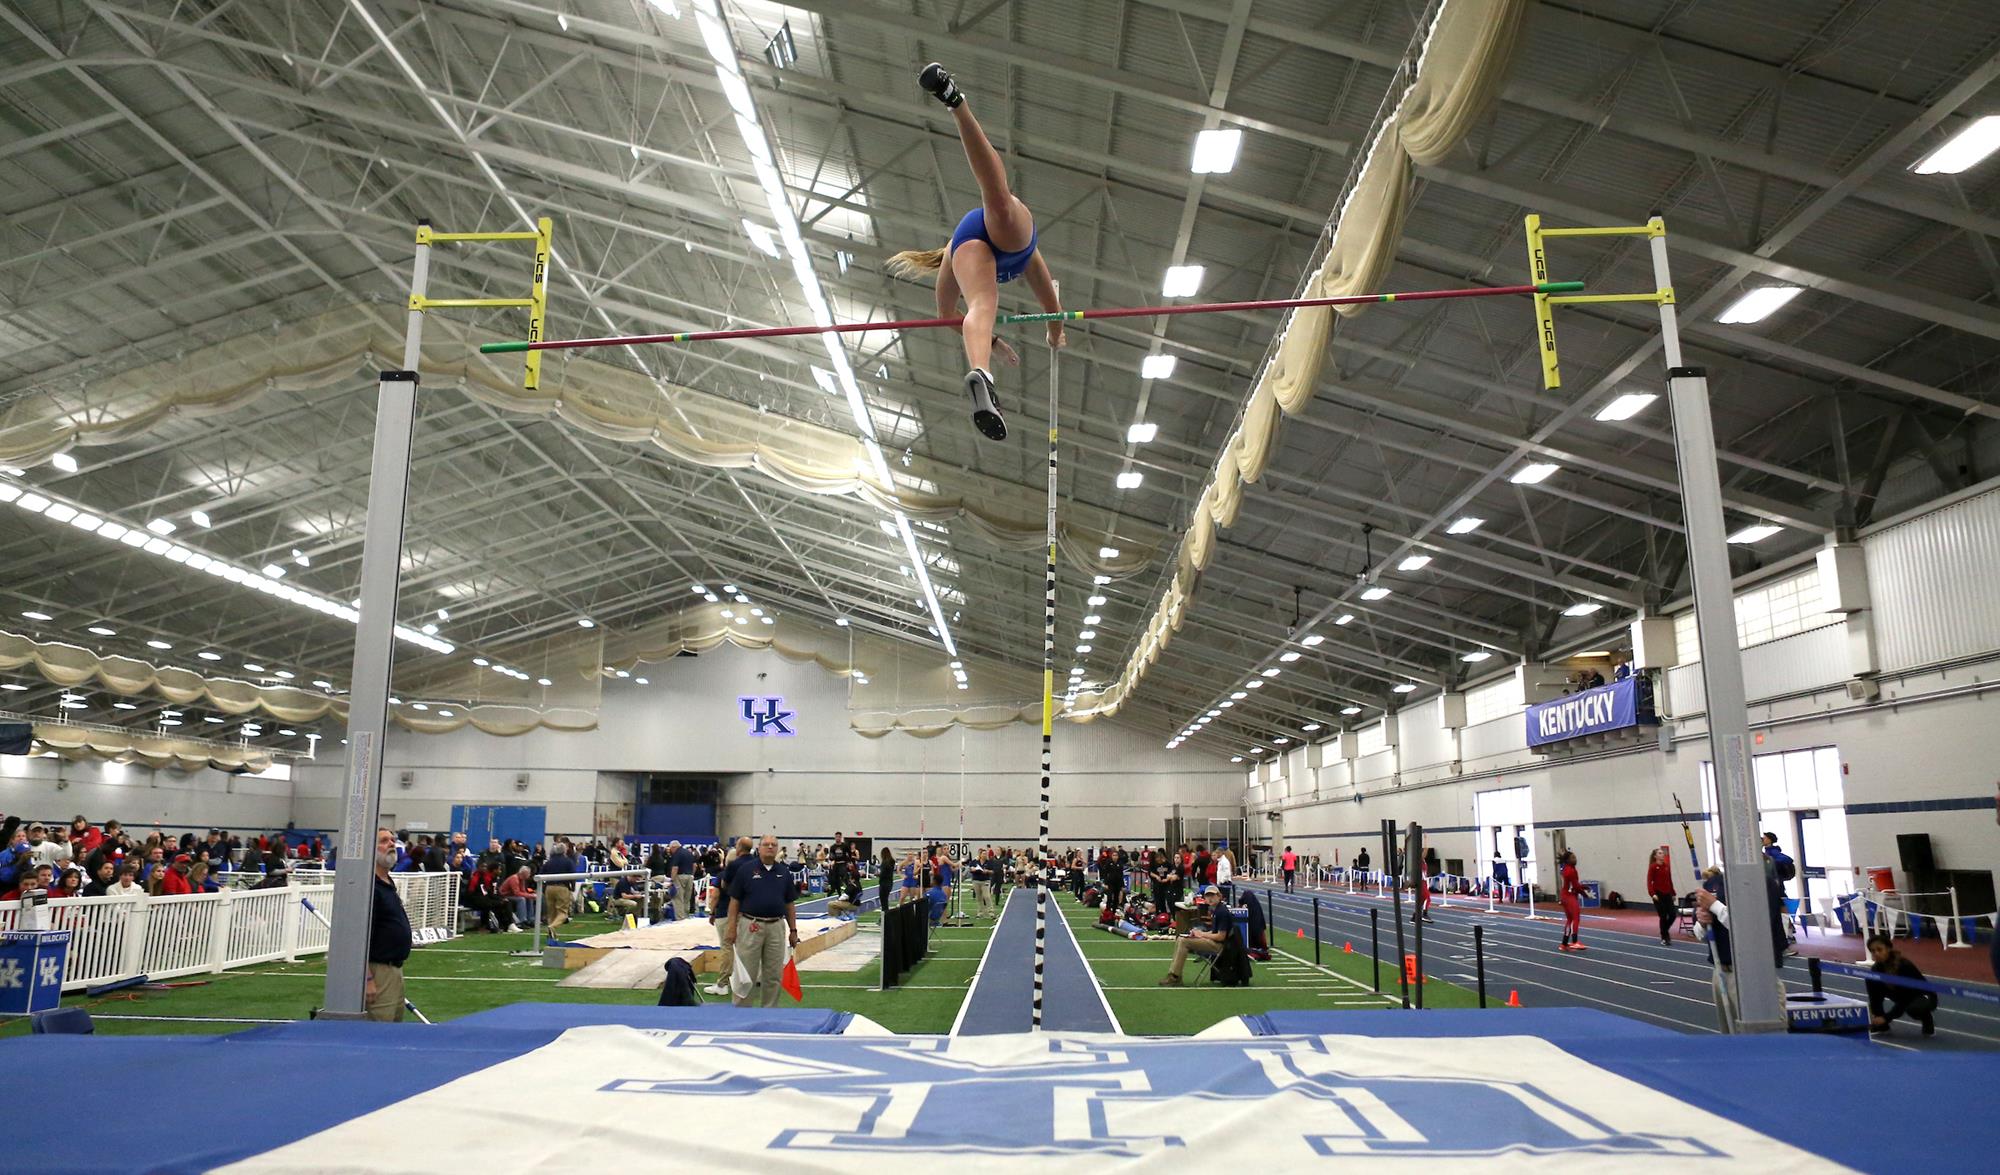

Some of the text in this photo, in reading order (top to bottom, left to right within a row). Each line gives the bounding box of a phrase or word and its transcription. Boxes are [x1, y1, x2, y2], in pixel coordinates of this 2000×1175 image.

[535, 253, 544, 284] UCS
[1534, 249, 1546, 280] UCS
[530, 318, 539, 343] UC
[1543, 319, 1555, 352] UCS
[739, 698, 795, 735] UK
[1539, 690, 1615, 737] KENTUCKY
[41, 933, 70, 943] WILDCATS
[40, 956, 60, 987] UK
[1792, 1007, 1862, 1020] KENTUCKY
